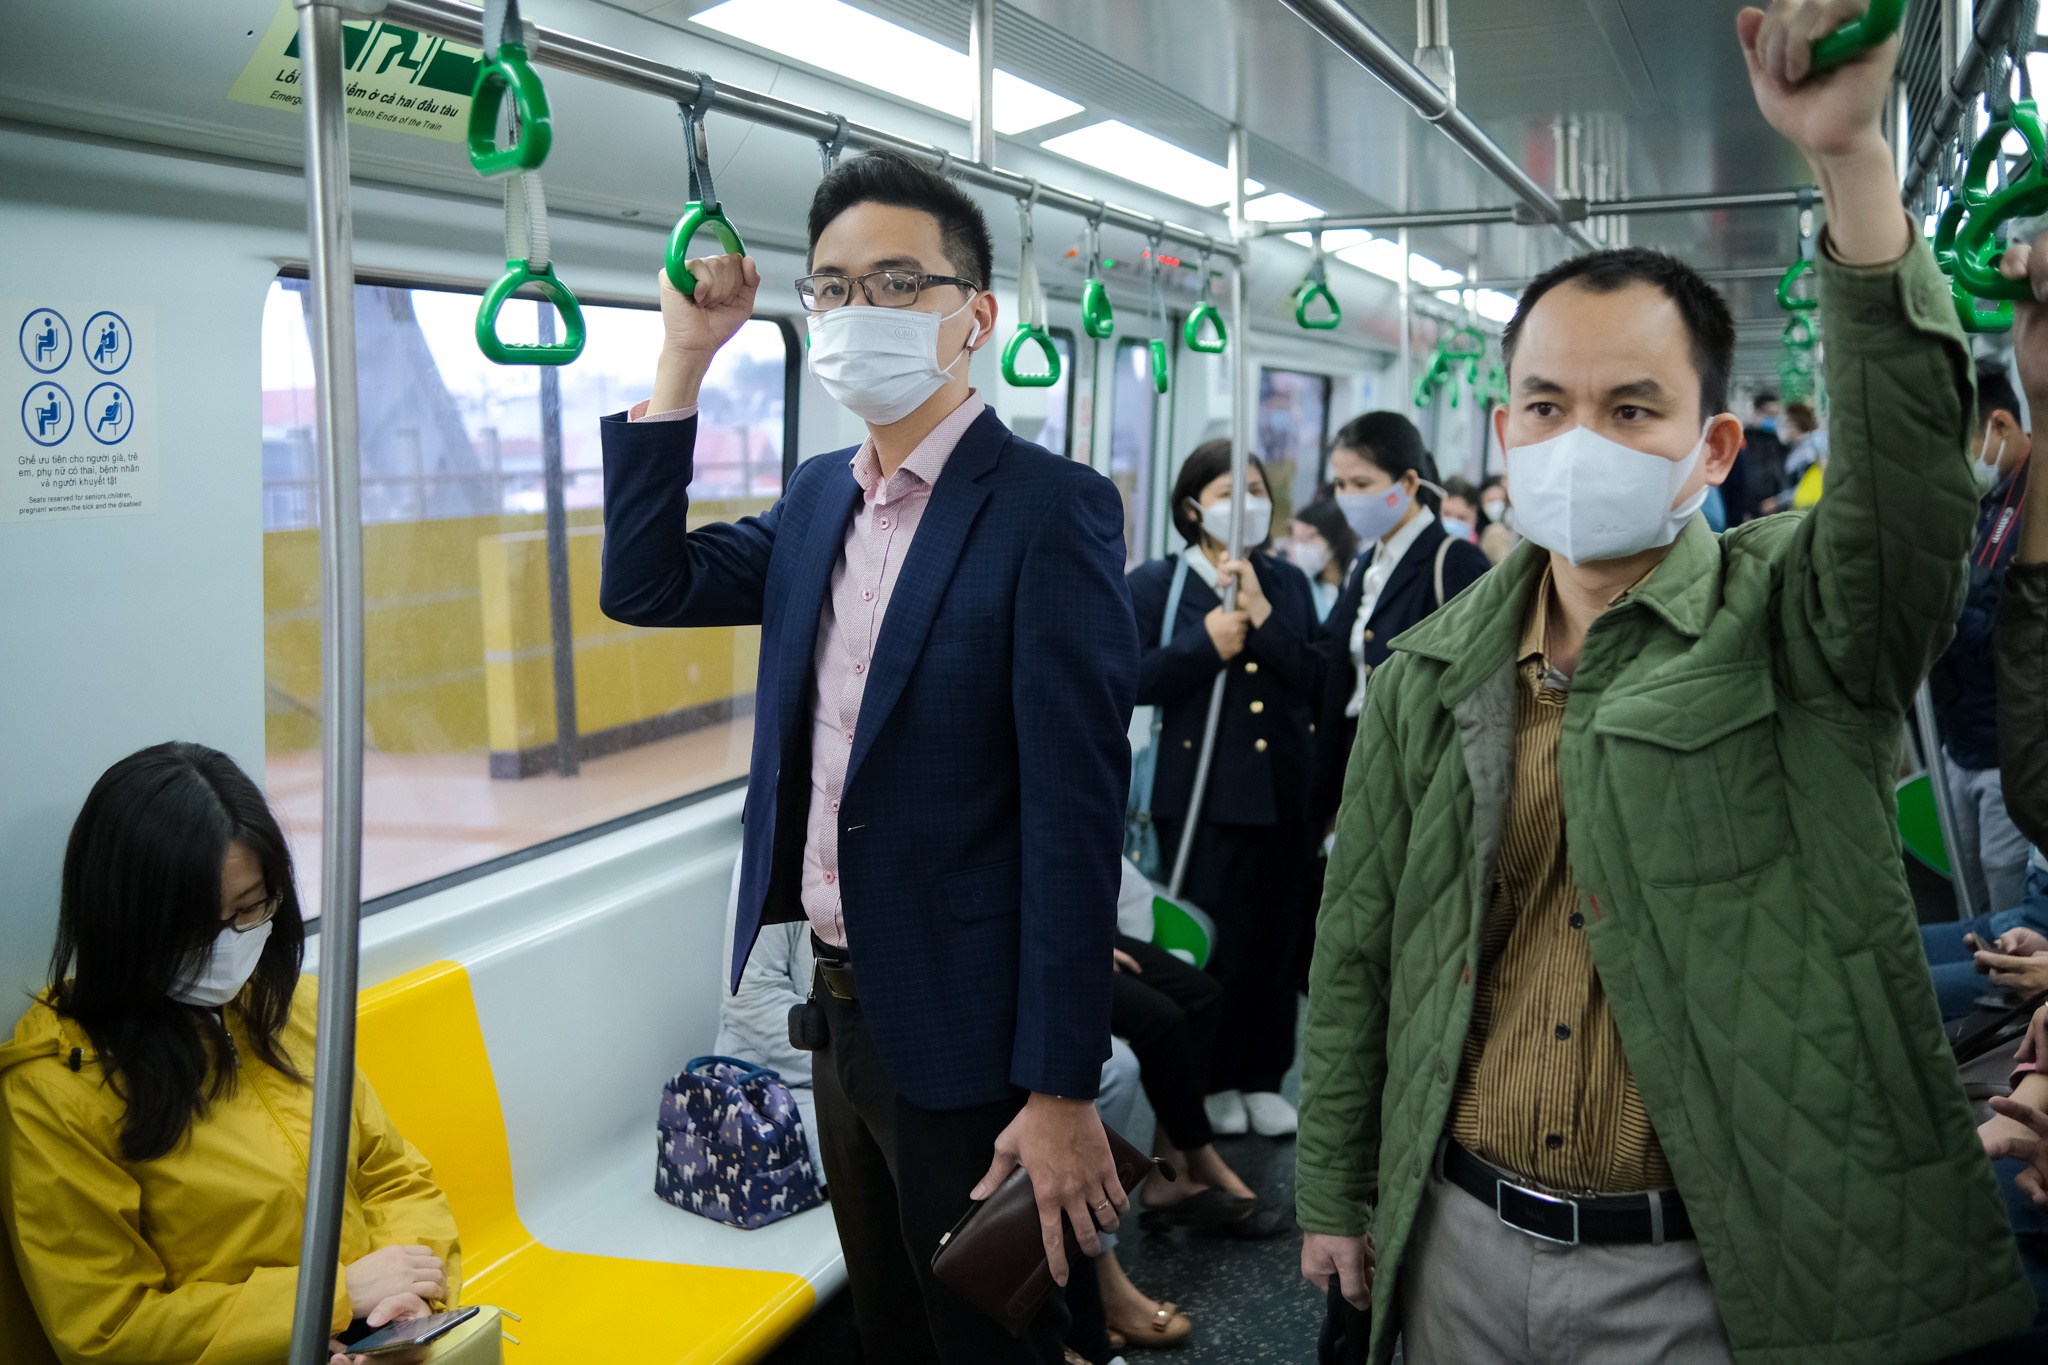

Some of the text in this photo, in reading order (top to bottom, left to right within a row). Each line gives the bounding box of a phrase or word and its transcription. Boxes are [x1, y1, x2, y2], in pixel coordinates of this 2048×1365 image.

[276, 69, 459, 117] Lối iểm ở cả hai đầu tàu
[355, 108, 375, 118] both
[376, 111, 397, 122] Ends
[399, 116, 409, 124] of
[408, 117, 422, 127] the
[423, 120, 443, 131] Train
[18, 454, 36, 465] Ghế
[38, 456, 50, 464] ưu
[52, 454, 67, 464] tiên
[69, 454, 84, 464] cho
[86, 453, 110, 465] người
[127, 452, 139, 461] trẻ
[18, 464, 140, 479] em, phụ nữ có thai, bệnh nhân
[53, 477, 77, 489] người
[79, 475, 106, 487] khuyết
[107, 476, 118, 485] tật
[29, 496, 46, 504] Seats
[47, 495, 74, 503] reserved
[19, 506, 47, 515] pregnant
[95, 502, 107, 510] and
[118, 500, 142, 508] disabled
